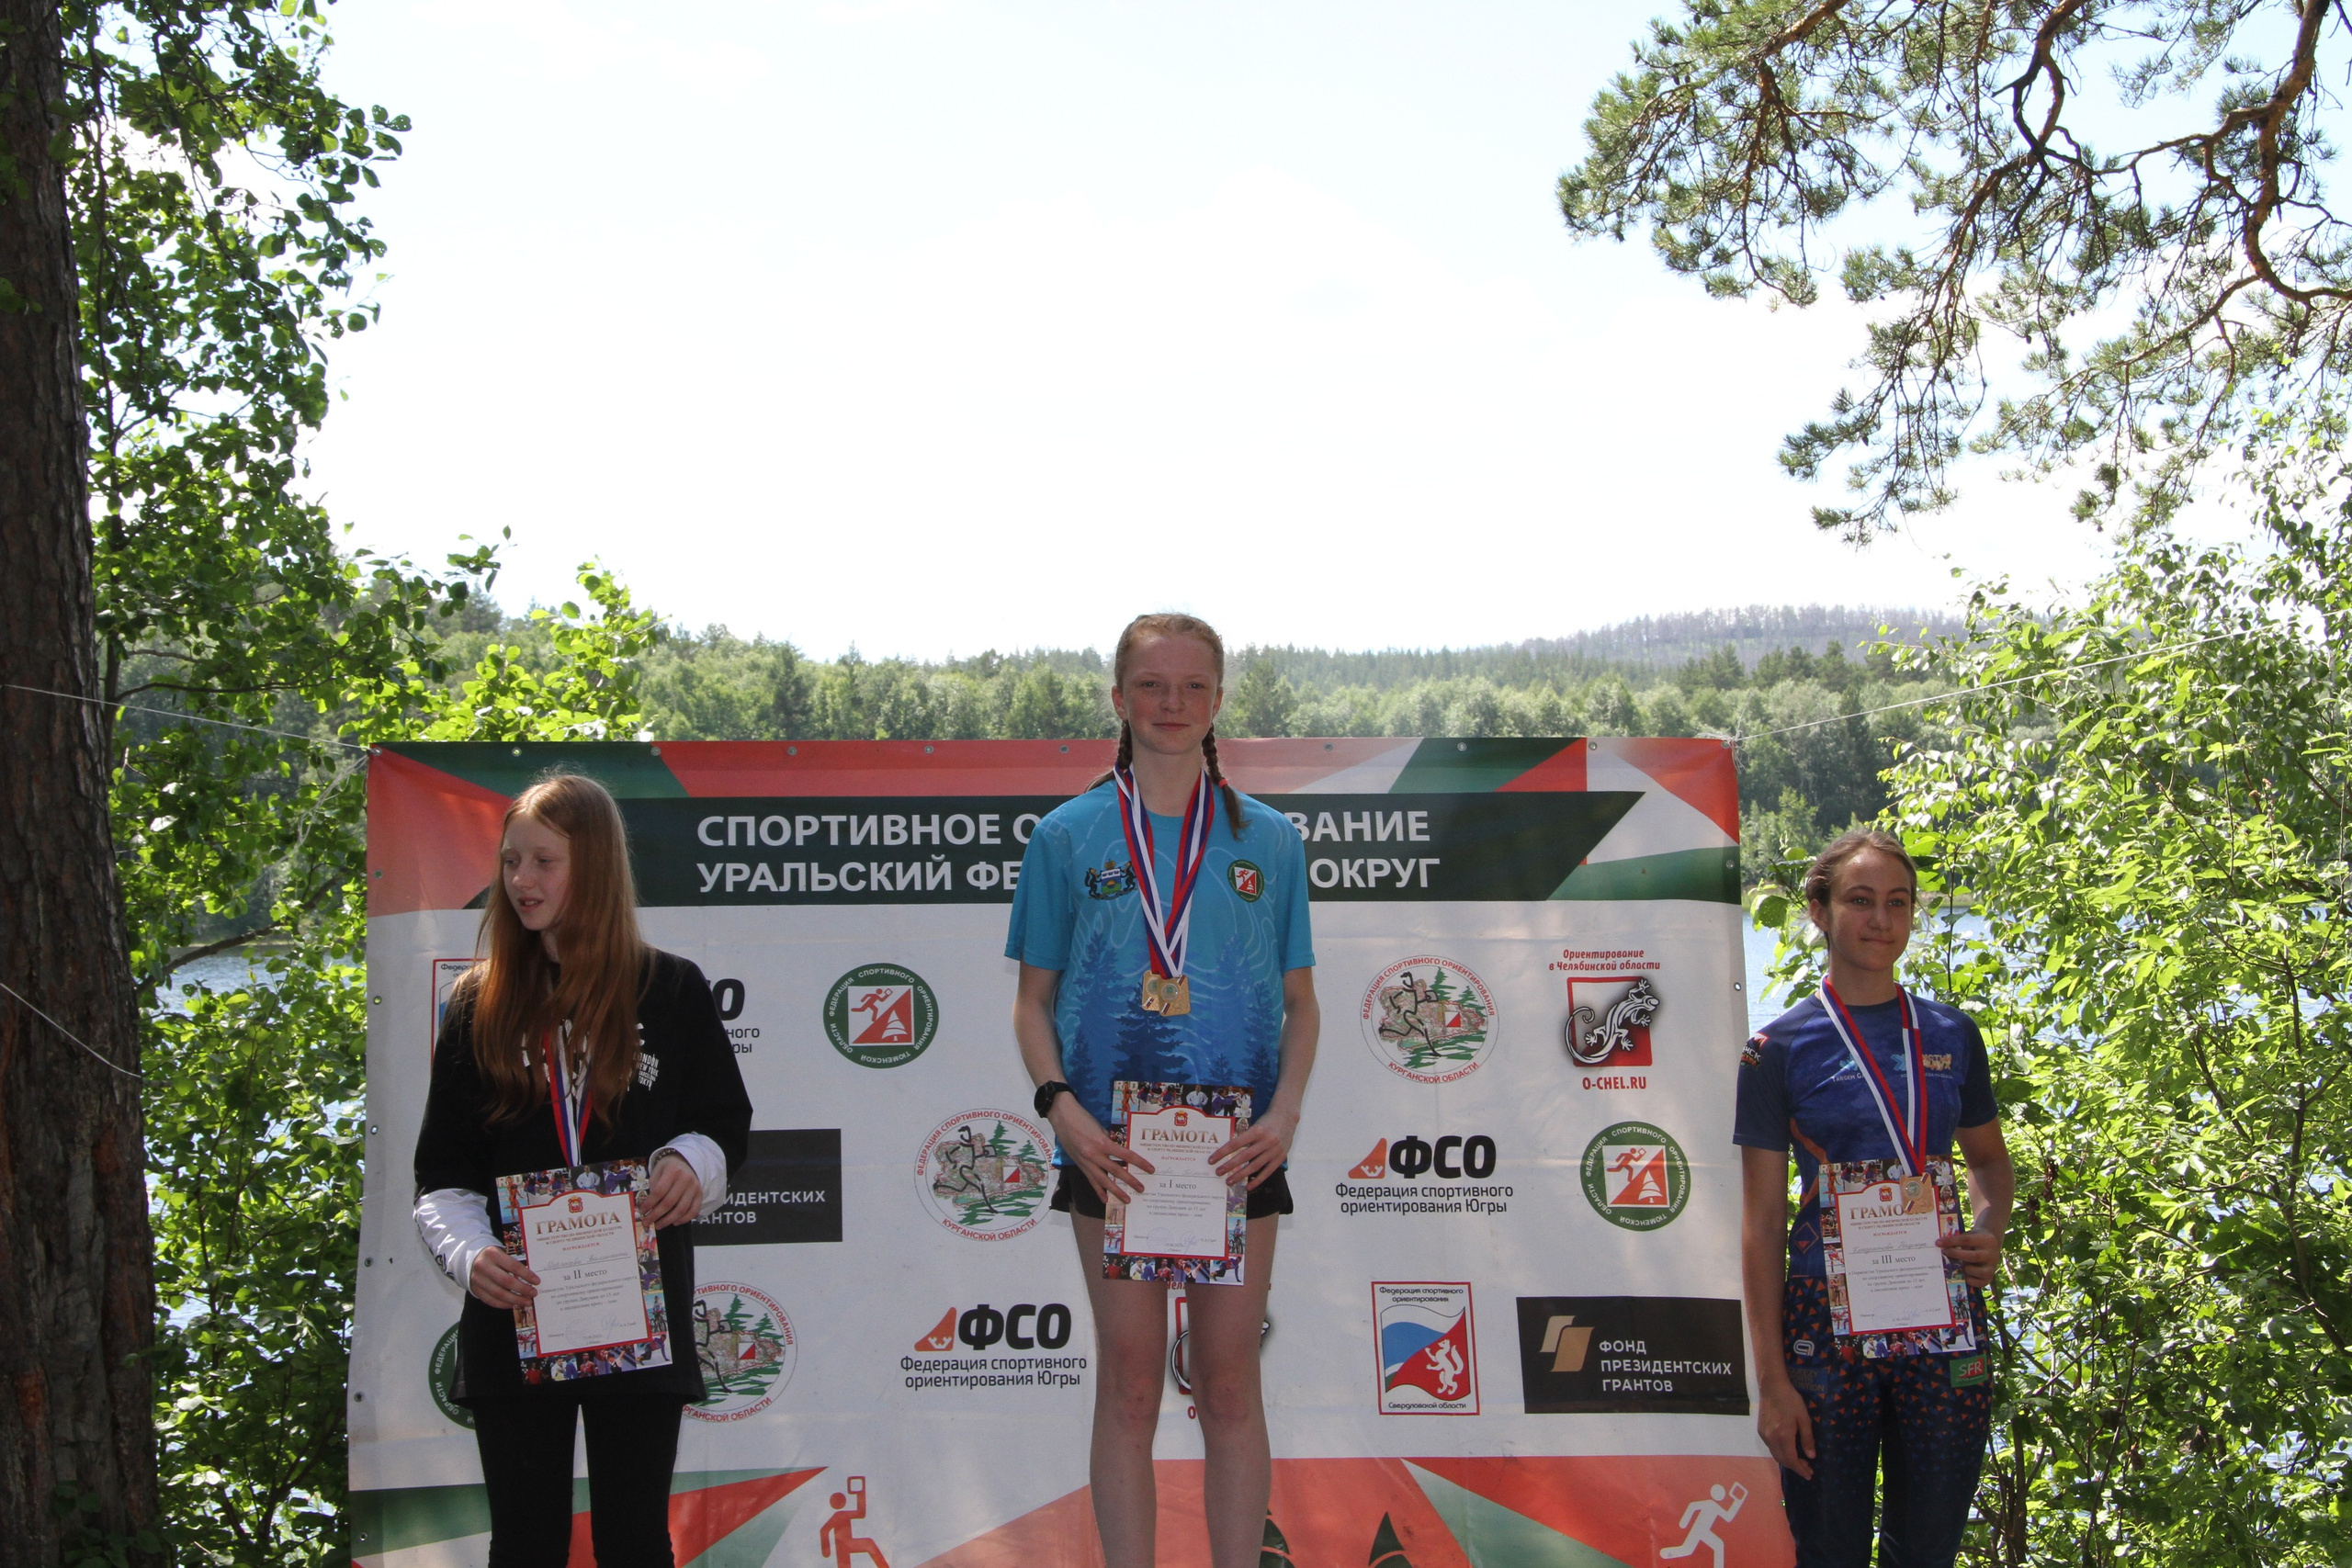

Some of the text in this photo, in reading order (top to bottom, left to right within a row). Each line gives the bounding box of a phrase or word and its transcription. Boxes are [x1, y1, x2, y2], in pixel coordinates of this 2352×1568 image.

[696, 813, 1001, 847] СПОРТИВНОЕ
[696, 853, 953, 893] УРАЛЬСКИЙ
[1309, 858, 1441, 889] ОКРУГ
[1563, 949, 1645, 961] Ориентирование
[441, 964, 468, 972] Федер
[1556, 961, 1617, 971] Челябинской
[1619, 960, 1660, 970] области
[1363, 957, 1495, 1020] ФЕДЕРАЦИЯ СПОРТИВНОГО ОРИЕНТИРОВАНИЯ
[829, 967, 933, 1064] ФЕДЕРАЦИЯ СПОРТИВНОГО ОРИЕНТИРОВАНИЯ ТЮМЕНСКОЙ ОБЛАСТИ
[732, 1043, 752, 1054] ры
[1388, 1062, 1479, 1084] КУРГАНСКОЙ ОБЛАСТИ
[1582, 1077, 1646, 1090] O-CHEL.RU
[917, 1129, 943, 1176] ФЕДЕРАЦИЯ
[940, 1111, 1001, 1132] СПОРТИВНОГО
[1141, 1128, 1219, 1144] ГРАМОТА
[1388, 1134, 1497, 1179] ФСО
[1585, 1126, 1686, 1226] ФЕДЕРАЦИЯ СПОРТИВНОГО ОРИЕНТИРОВАНИЯ ТЮМЕНСКОЙ ОБЛАСТИ
[723, 1190, 826, 1206] ИДЕНТСКИХ
[1335, 1182, 1513, 1201] Федерация спортивного
[1340, 1199, 1507, 1216] ориентирования Югры
[1849, 1204, 1904, 1220] ГРАМО
[535, 1212, 621, 1235] ГРАМОТА
[691, 1211, 757, 1224] АНТОВ
[942, 1218, 1036, 1241] КУРГАНСКОЙ ОБЛАСТИ
[1881, 1255, 1893, 1264] III
[573, 1269, 582, 1280] II
[584, 1269, 607, 1278] место
[1379, 1286, 1421, 1295] Федерация
[695, 1284, 794, 1346] ТИВНОГО ОРИЕНТИРОВАНИЯ
[958, 1303, 1072, 1351] ФСО
[1599, 1339, 1647, 1355] ФОНД
[900, 1356, 1087, 1374] Федерация спортивного
[1600, 1359, 1732, 1375] ПРЕЗИДЕНТСКИХ
[1959, 1360, 1982, 1376] SFR
[905, 1371, 1080, 1391] ориентирования Югры
[1602, 1379, 1673, 1392] ГРАНТОВ
[683, 1397, 772, 1422] РГАНСКОЙ ОБЛАСТИ
[1388, 1402, 1437, 1410] Свердловской
